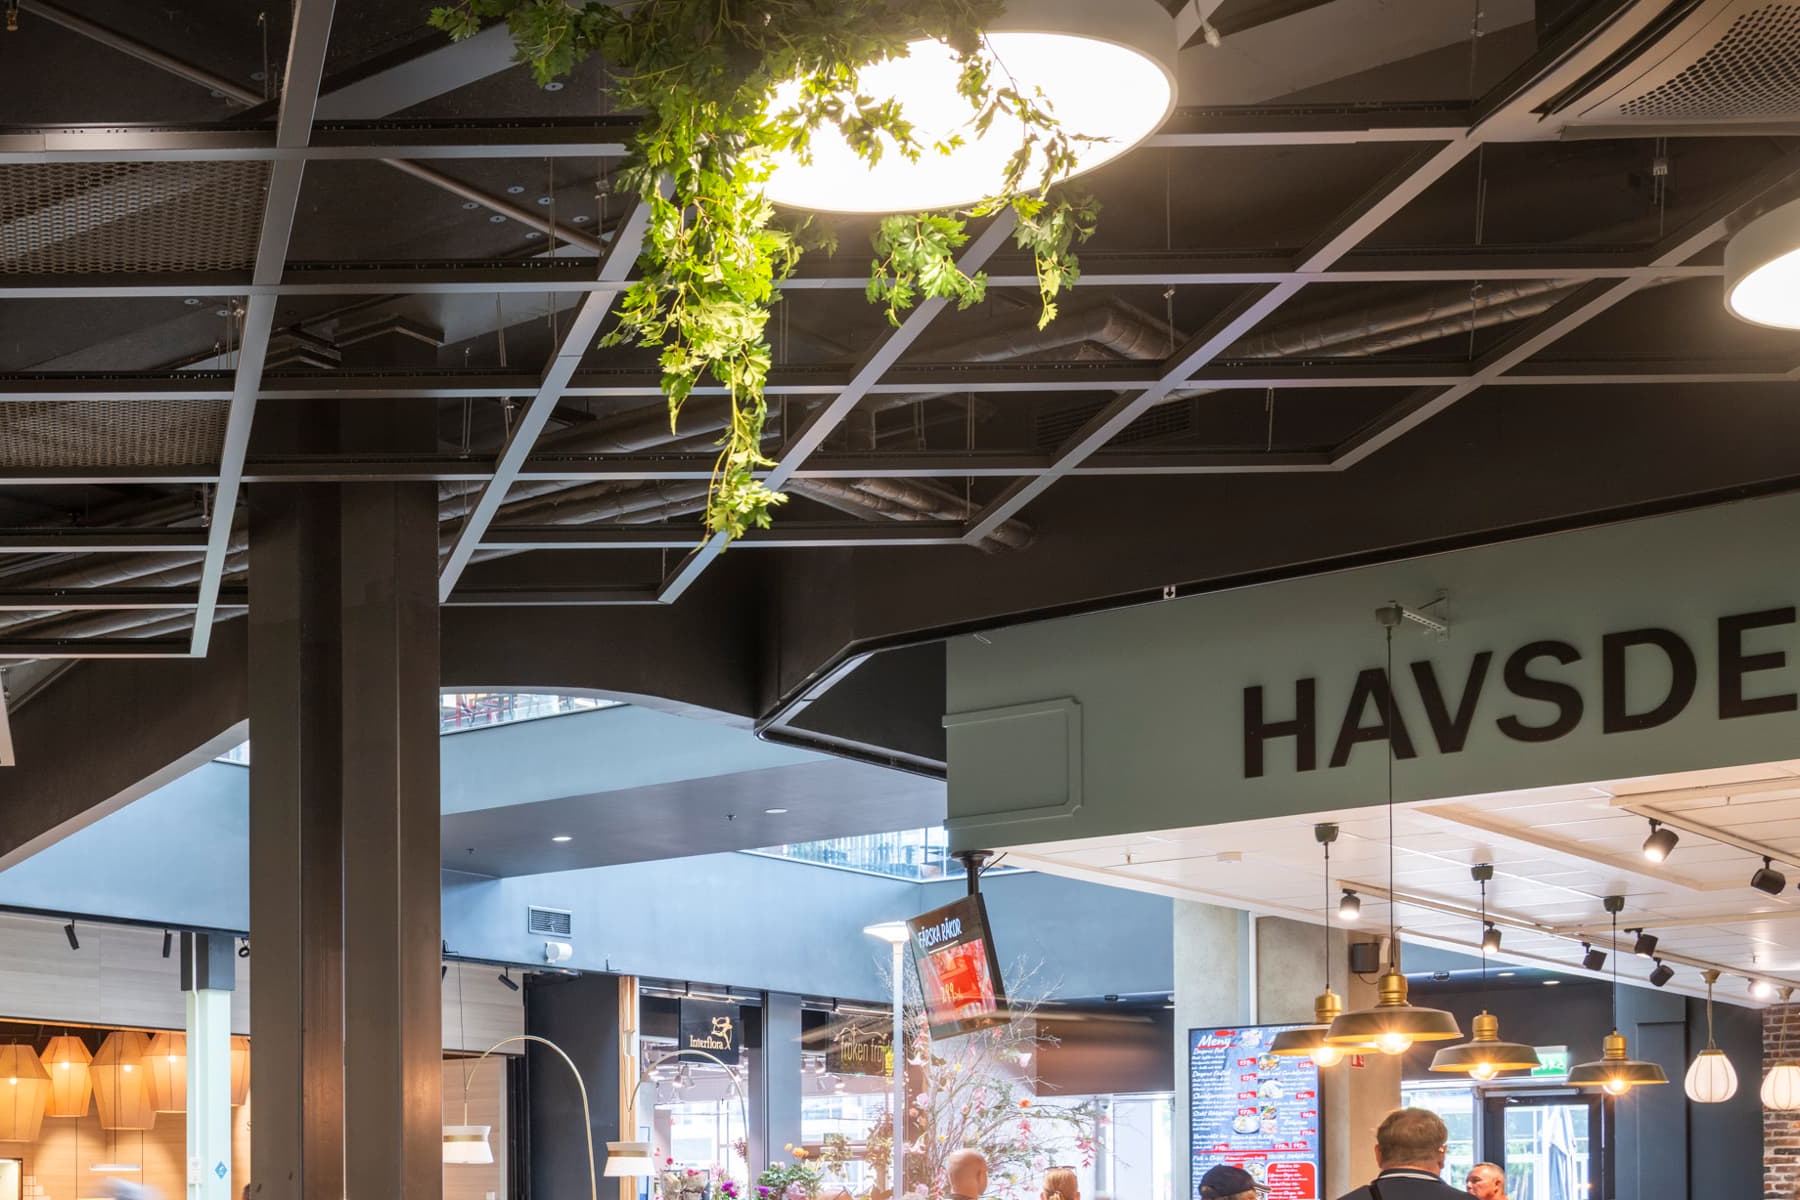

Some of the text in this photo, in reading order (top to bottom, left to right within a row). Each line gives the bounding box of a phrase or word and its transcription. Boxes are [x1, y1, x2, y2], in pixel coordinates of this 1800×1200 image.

[1242, 606, 1799, 778] HAVSDE
[689, 1034, 724, 1050] Interflora
[1198, 1035, 1232, 1048] Meny
